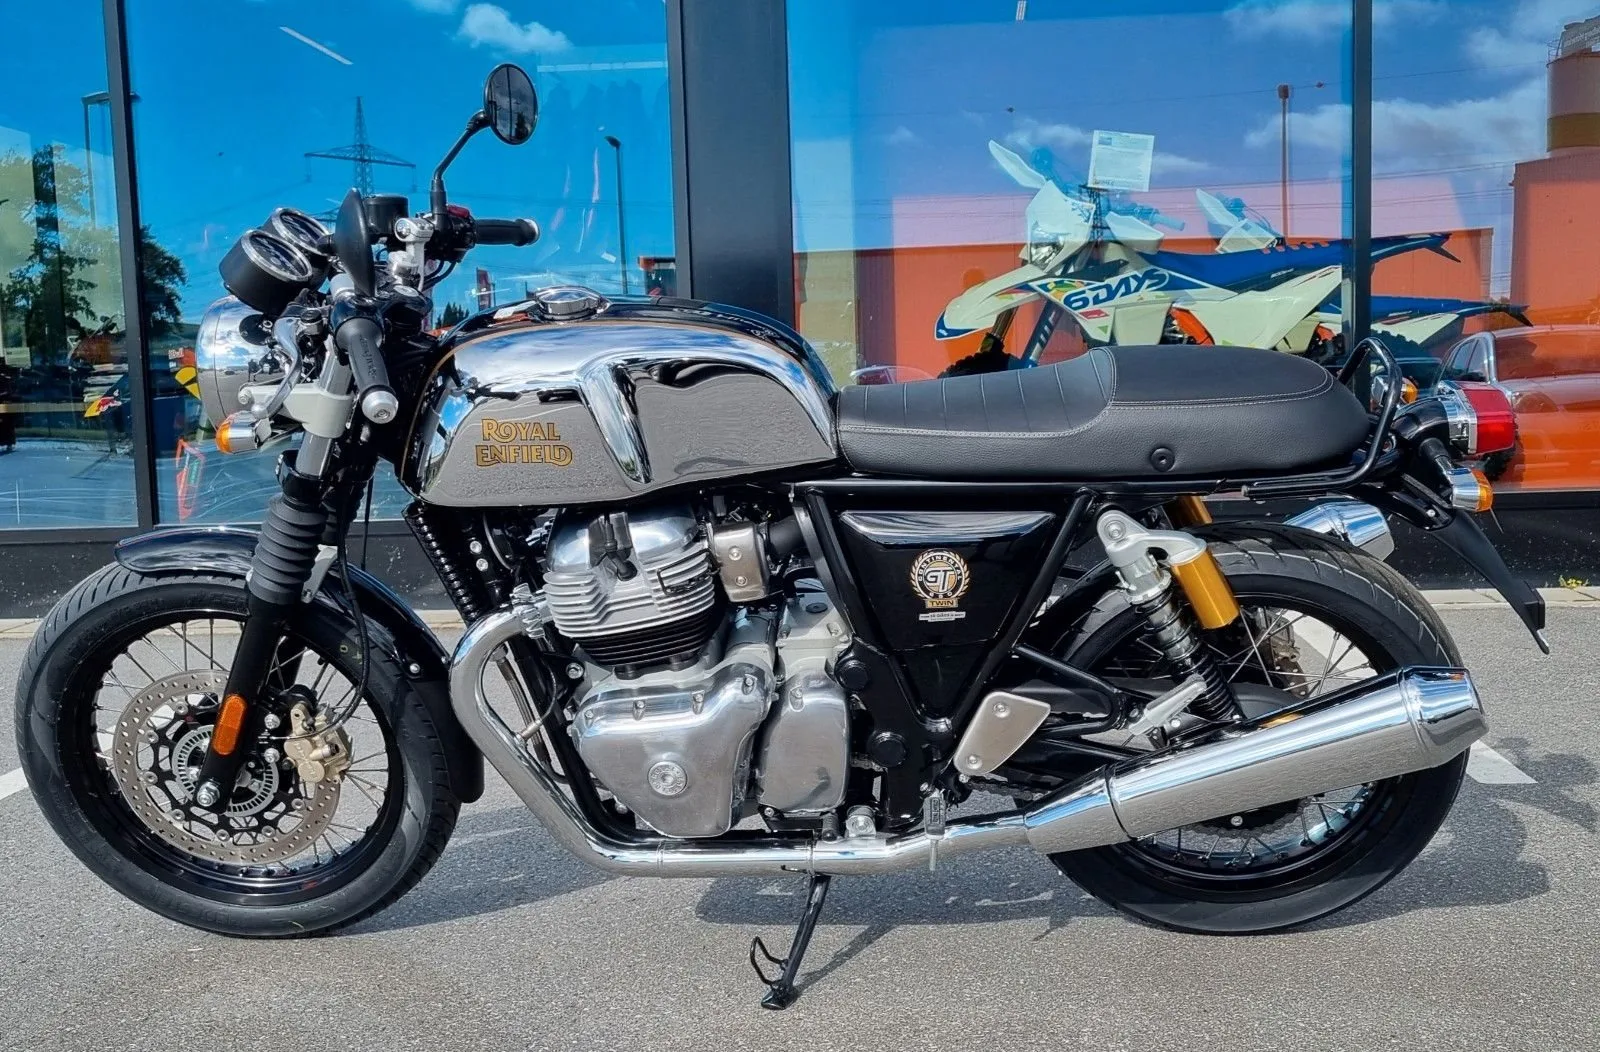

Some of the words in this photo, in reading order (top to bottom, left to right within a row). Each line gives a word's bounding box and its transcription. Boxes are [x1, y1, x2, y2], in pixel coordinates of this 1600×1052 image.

[1063, 268, 1168, 311] 6DAYS
[481, 418, 561, 443] ROYAL
[475, 444, 573, 467] ENFIELD
[918, 556, 962, 582] CONTINENTAL
[924, 567, 955, 593] GT
